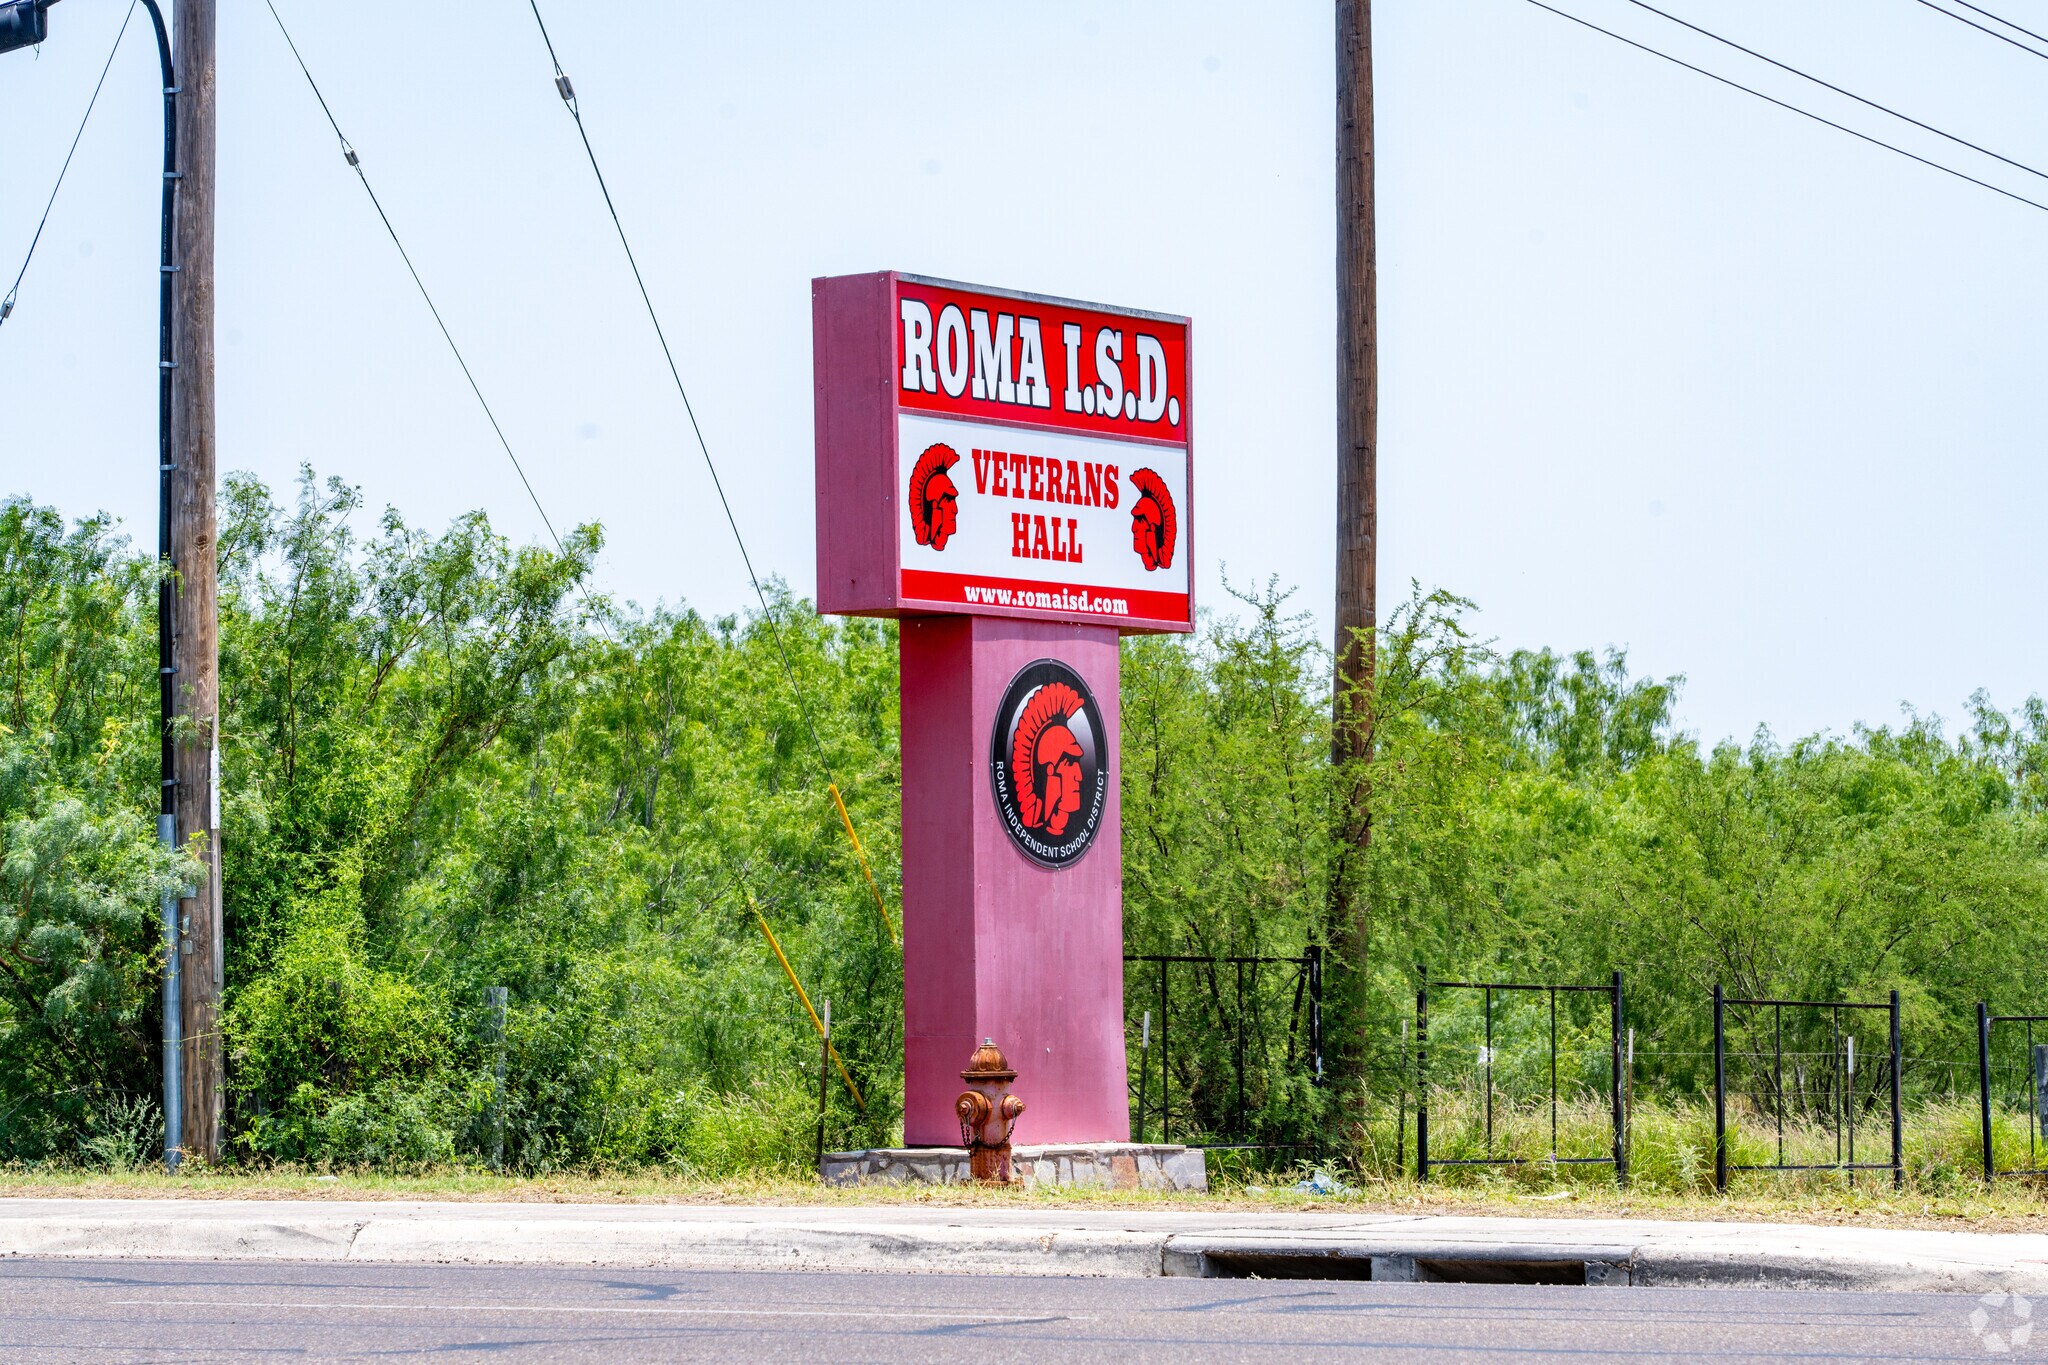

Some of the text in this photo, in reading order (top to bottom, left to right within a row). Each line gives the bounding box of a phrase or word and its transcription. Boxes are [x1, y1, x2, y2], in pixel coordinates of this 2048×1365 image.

[901, 298, 1181, 426] ROMA I.S.D.
[972, 449, 1119, 509] VETERANS
[1012, 512, 1083, 563] HALL
[964, 586, 1128, 614] www.romaisd.com
[996, 761, 1104, 858] ROMA INDEPENDENT SCHOOL DISTRICT
